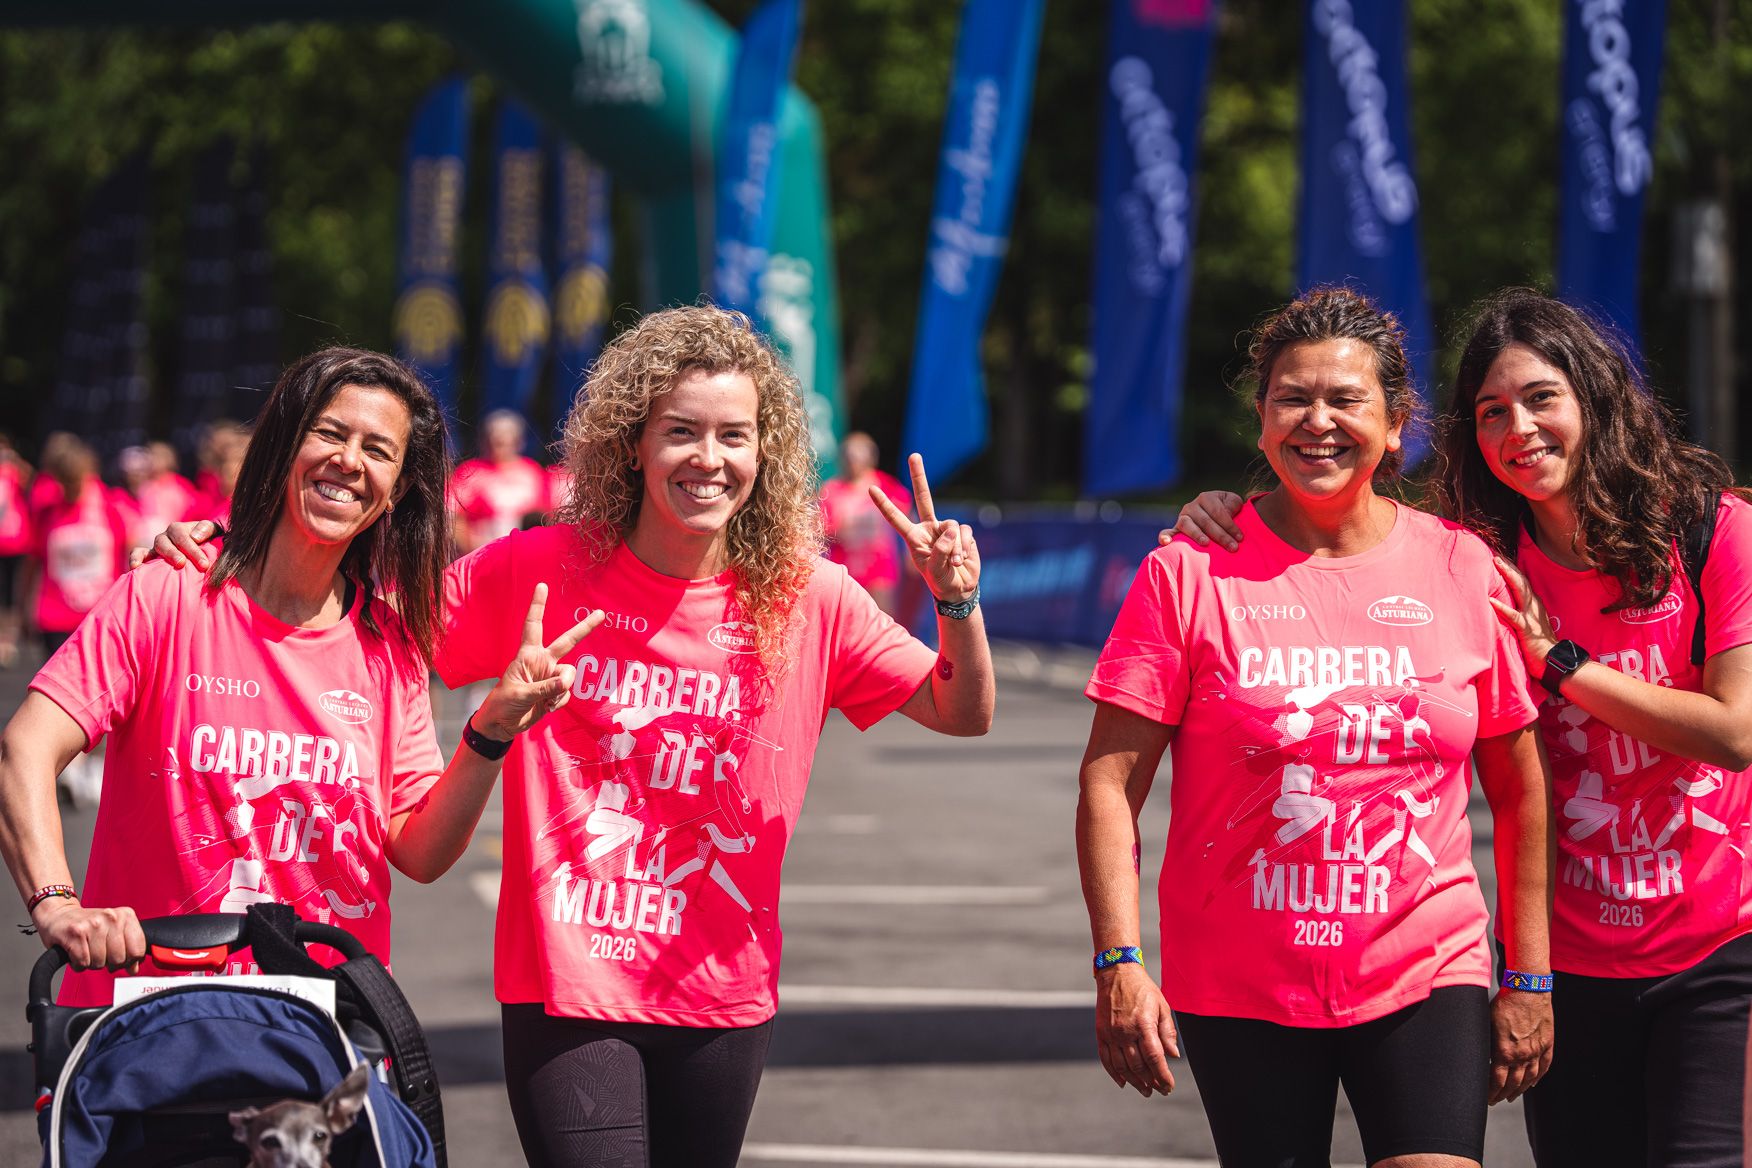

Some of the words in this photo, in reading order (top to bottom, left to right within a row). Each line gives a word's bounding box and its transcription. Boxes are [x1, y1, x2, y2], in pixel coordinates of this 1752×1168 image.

[574, 606, 648, 633] OSHO
[1231, 604, 1306, 622] OYSHO
[1373, 606, 1429, 621] ASTURIANA
[712, 629, 756, 647] ASTURIA
[186, 673, 260, 697] OYSHO
[573, 654, 741, 721] CARRERA
[1237, 645, 1420, 689] CARRERA
[323, 697, 369, 719] ASTURIANA
[190, 723, 361, 789] CARRERA
[1332, 702, 1398, 765] DE
[649, 727, 713, 796] DE
[266, 797, 333, 863] DE
[1320, 799, 1366, 861] LA
[1609, 797, 1654, 854] LA
[623, 821, 667, 883] LA
[552, 871, 688, 936] MUJER
[1251, 859, 1392, 914] MUJER
[1293, 919, 1344, 947] 2026
[1599, 901, 1644, 927] 2026
[589, 933, 637, 962] 2026
